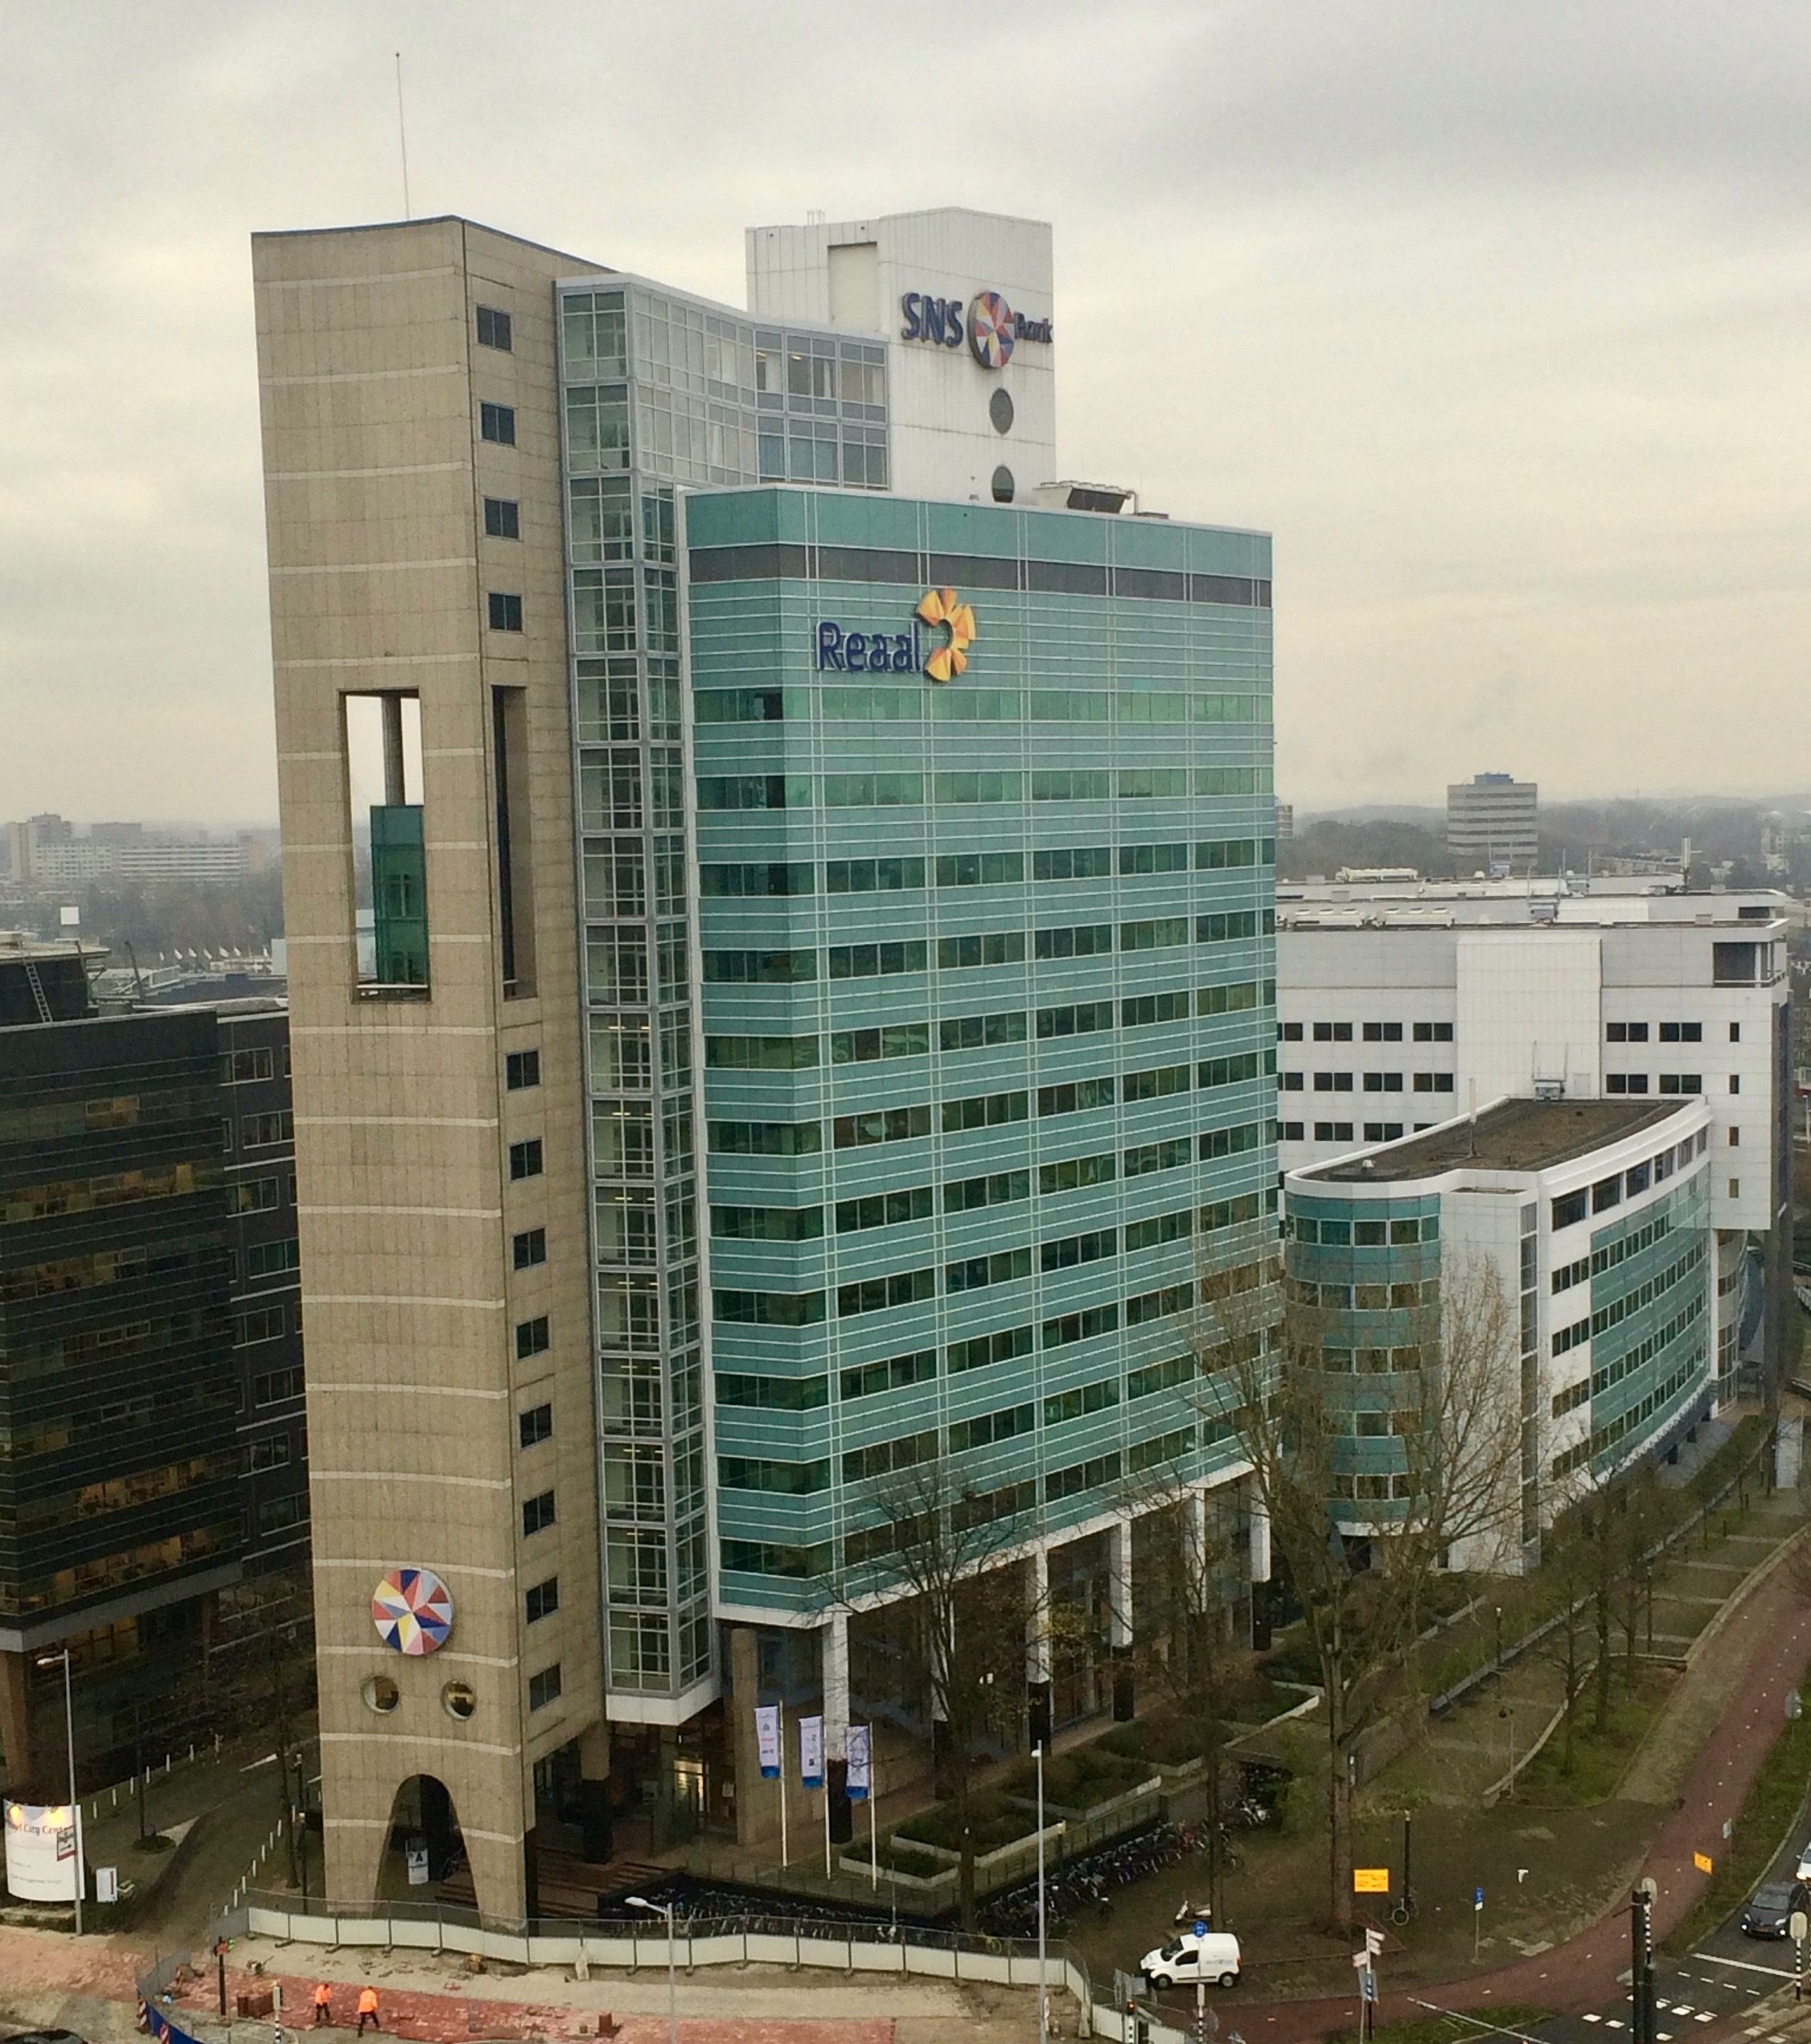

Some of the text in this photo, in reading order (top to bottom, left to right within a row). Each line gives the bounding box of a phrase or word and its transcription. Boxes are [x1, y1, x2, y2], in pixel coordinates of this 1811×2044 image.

[901, 292, 1053, 348] SNS Bank
[815, 618, 920, 673] Reaal
